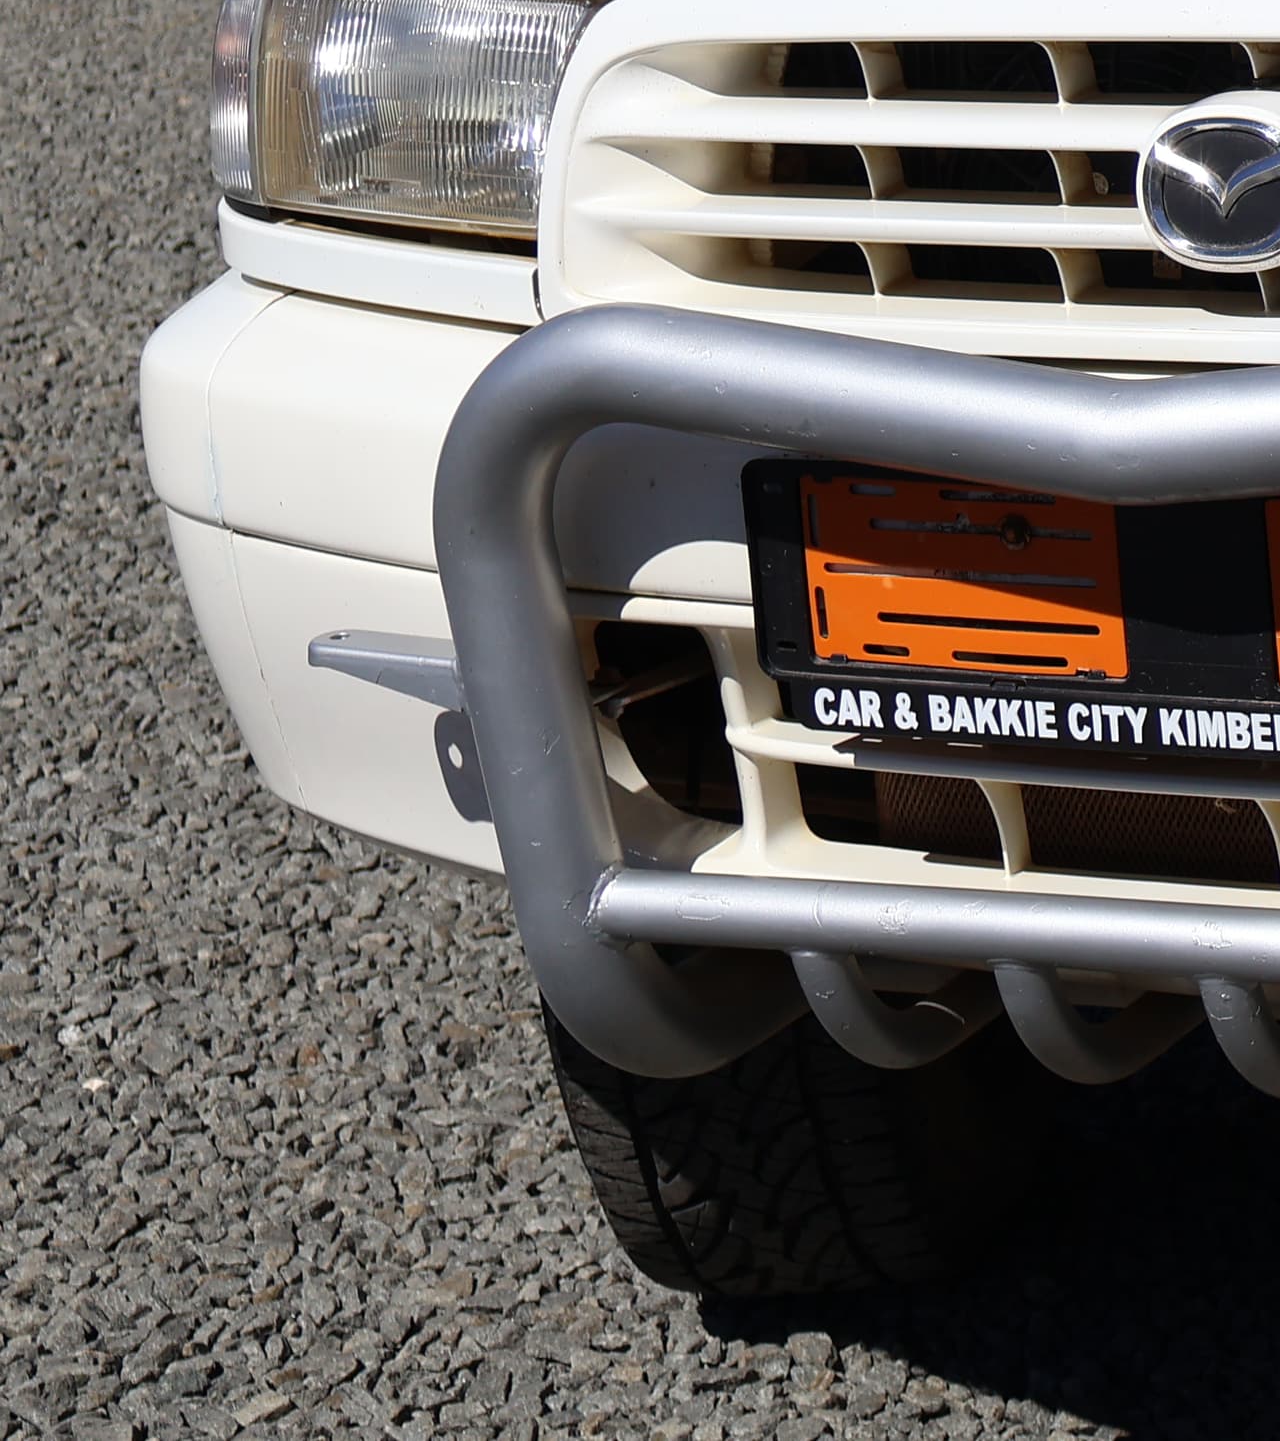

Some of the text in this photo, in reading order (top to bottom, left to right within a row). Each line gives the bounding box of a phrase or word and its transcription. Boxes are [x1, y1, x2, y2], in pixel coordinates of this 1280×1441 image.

[814, 688, 884, 728] CAR
[895, 692, 919, 730] &
[928, 694, 1058, 739] BAKKIE
[1068, 703, 1147, 744] CITY
